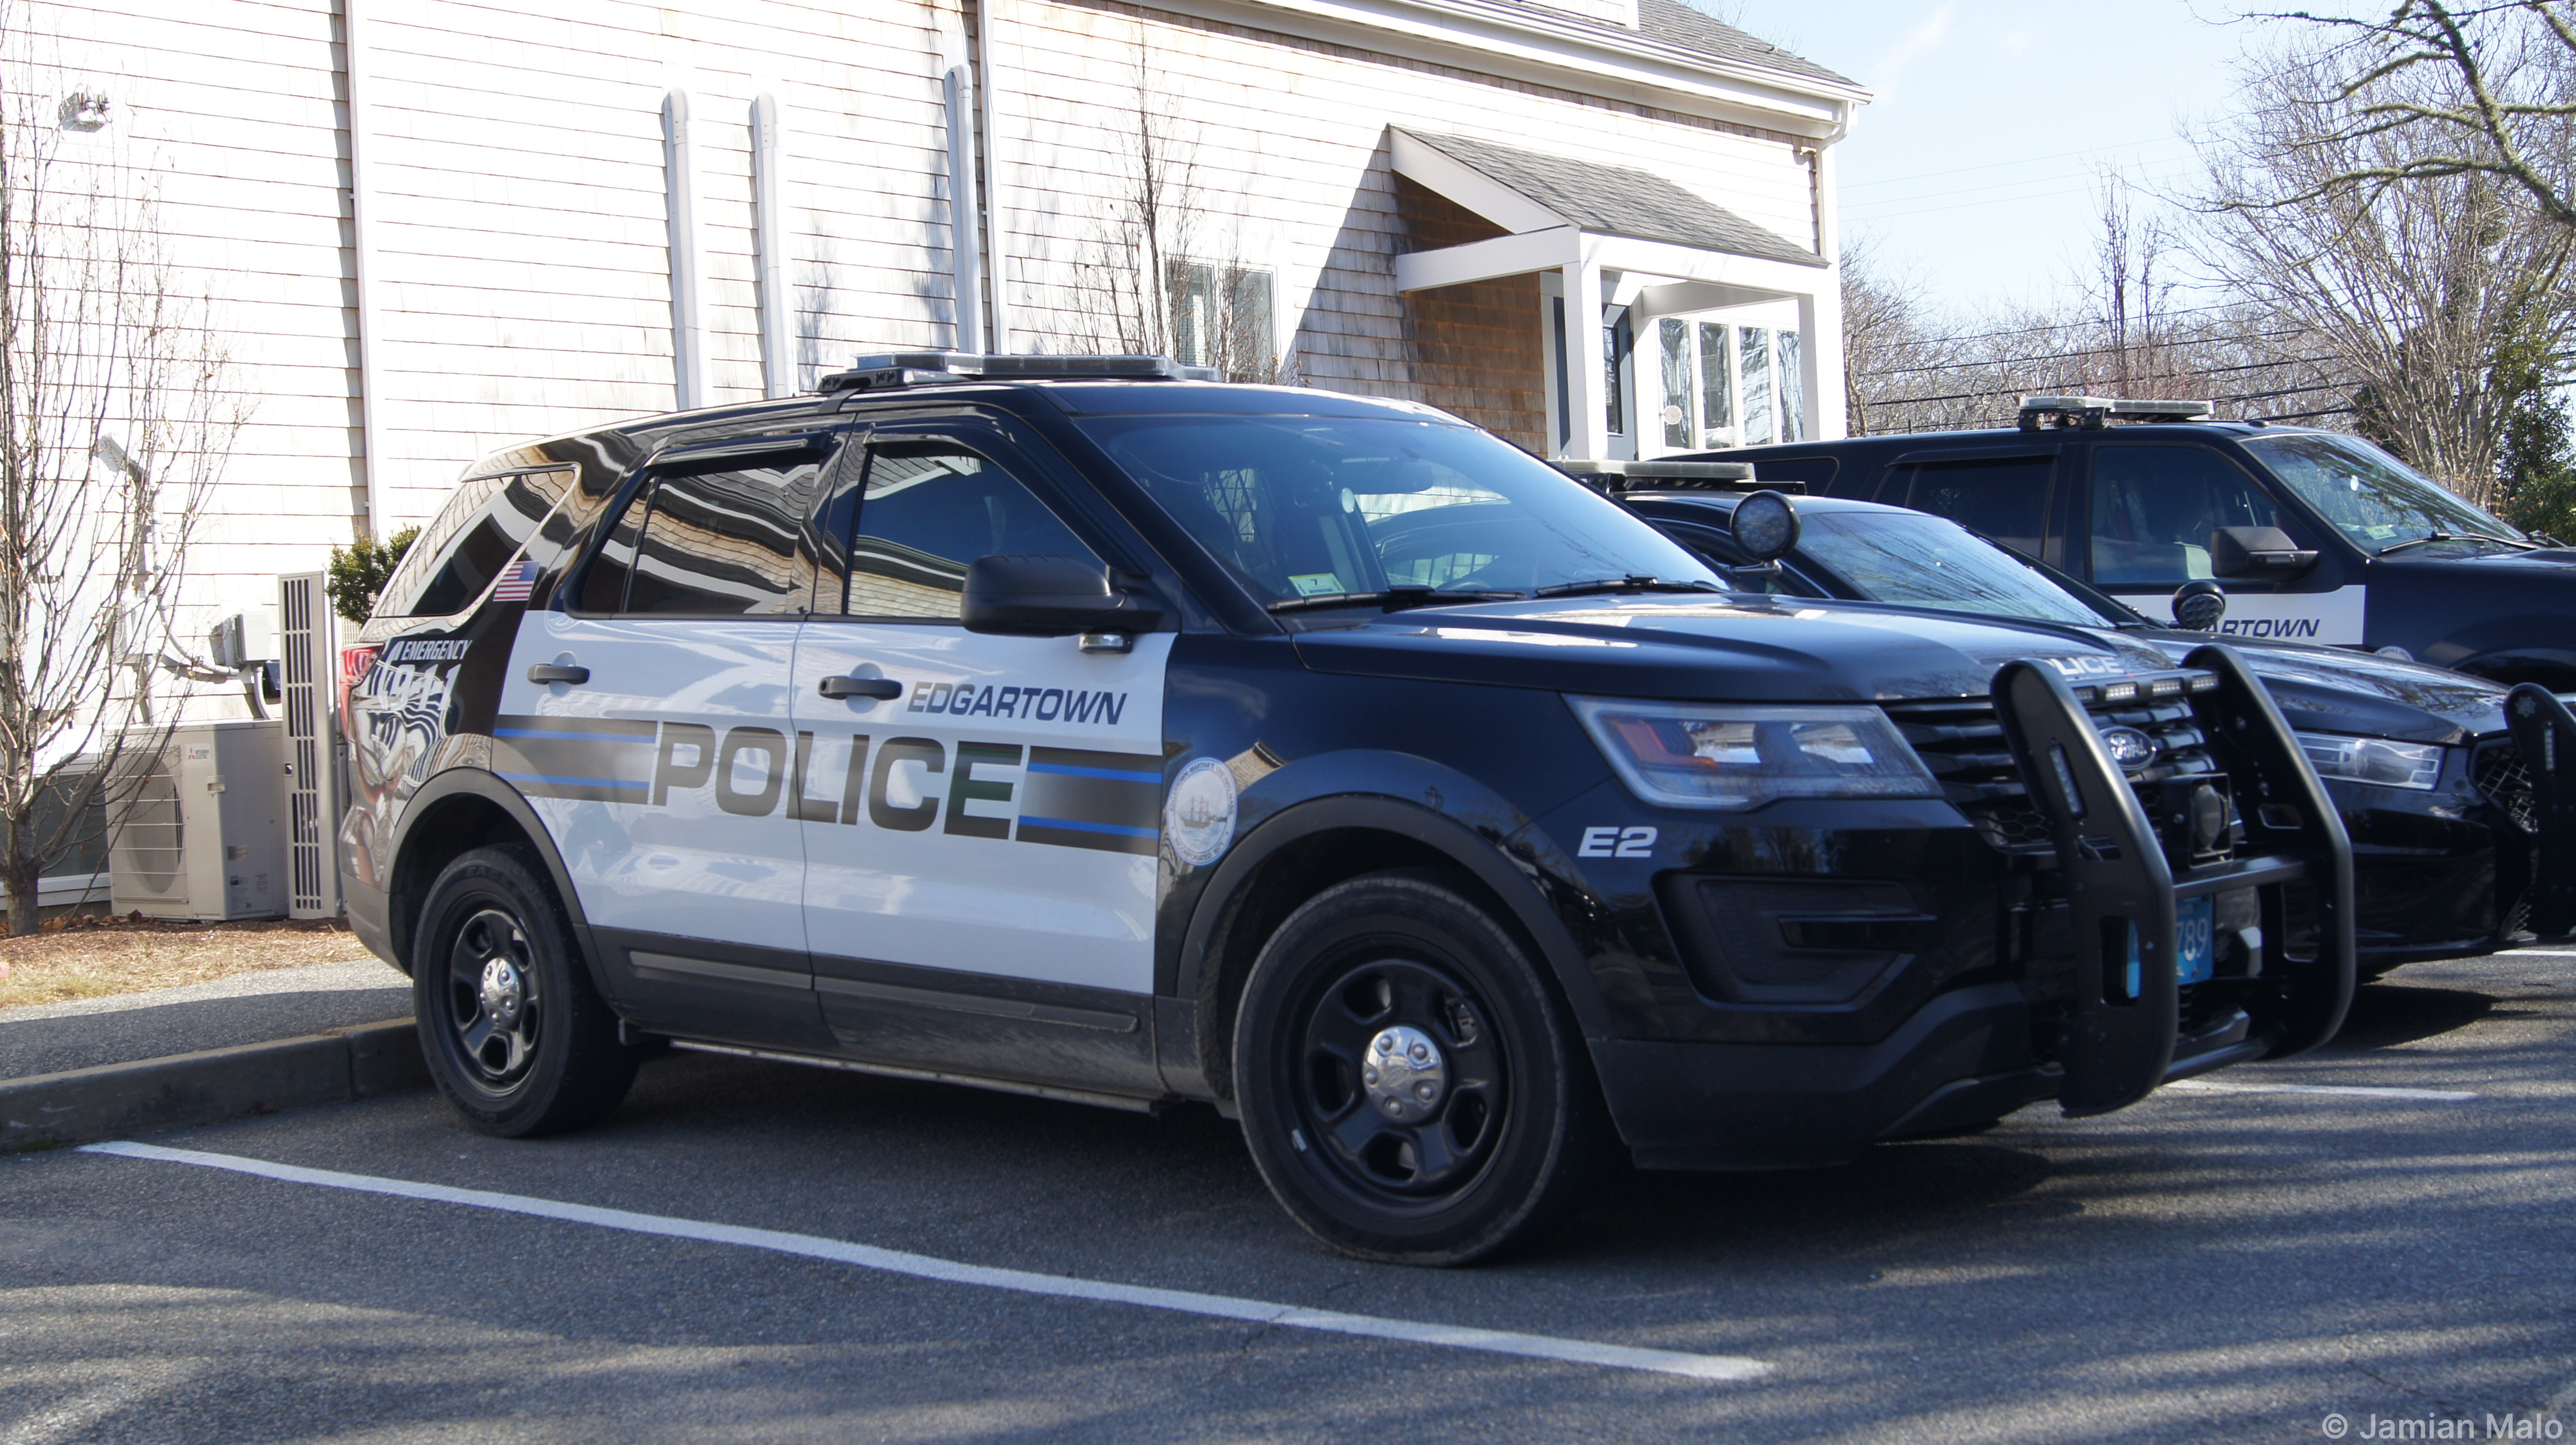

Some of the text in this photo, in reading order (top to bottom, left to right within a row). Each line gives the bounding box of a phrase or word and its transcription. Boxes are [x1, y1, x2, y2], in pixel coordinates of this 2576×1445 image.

[2205, 618, 2320, 638] ARTOWN
[400, 639, 473, 661] EMERGENCY
[2049, 656, 2126, 676] LICE
[907, 681, 1128, 725] EDGARTOWN
[2110, 733, 2147, 760] Ford
[652, 721, 1023, 840] POLICE
[1577, 826, 1658, 858] E2
